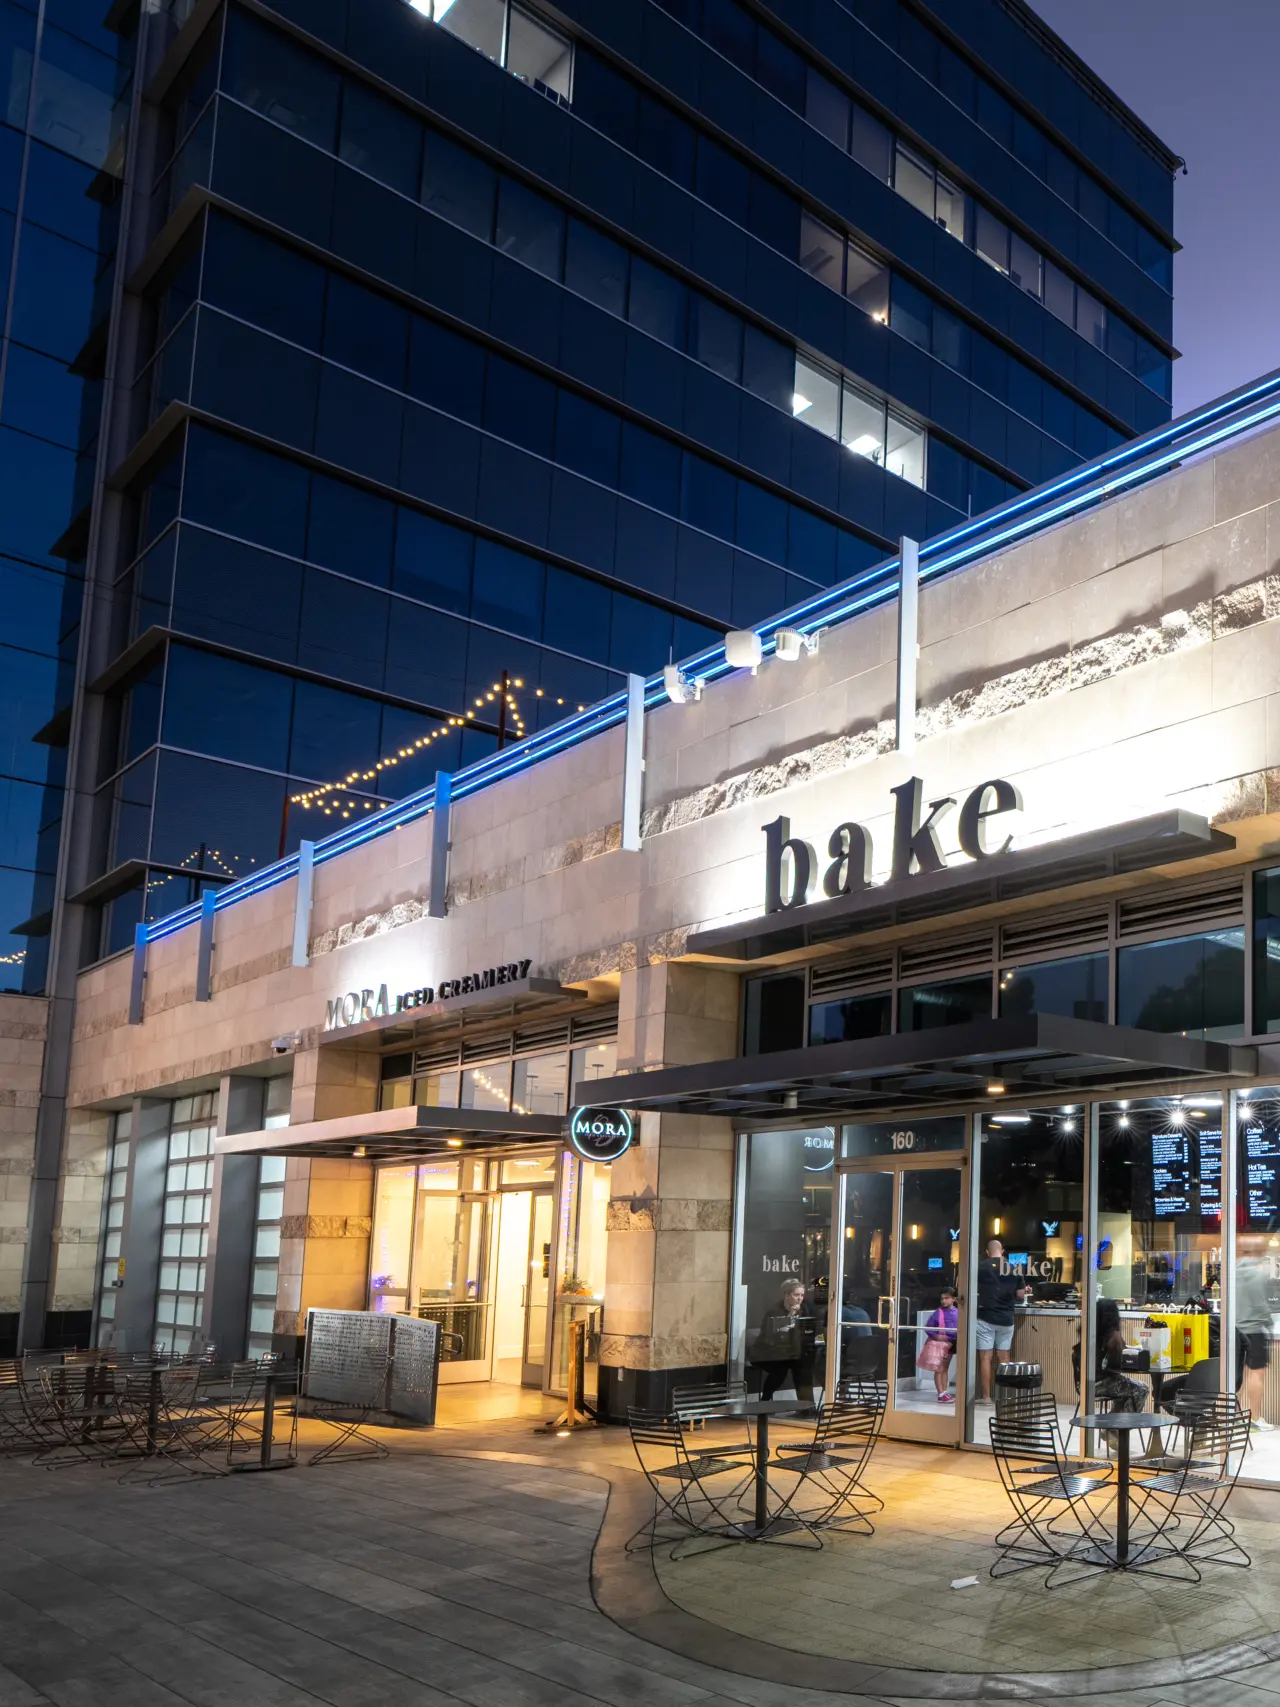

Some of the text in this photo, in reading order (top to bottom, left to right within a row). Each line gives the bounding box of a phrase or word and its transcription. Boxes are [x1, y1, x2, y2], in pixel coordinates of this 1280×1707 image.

[761, 775, 1024, 915] bake
[324, 959, 533, 1032] MORA ICED CREAMERY
[576, 1120, 627, 1136] MORA
[891, 1131, 914, 1150] 160
[762, 1254, 800, 1273] bake
[999, 1256, 1051, 1277] bake
